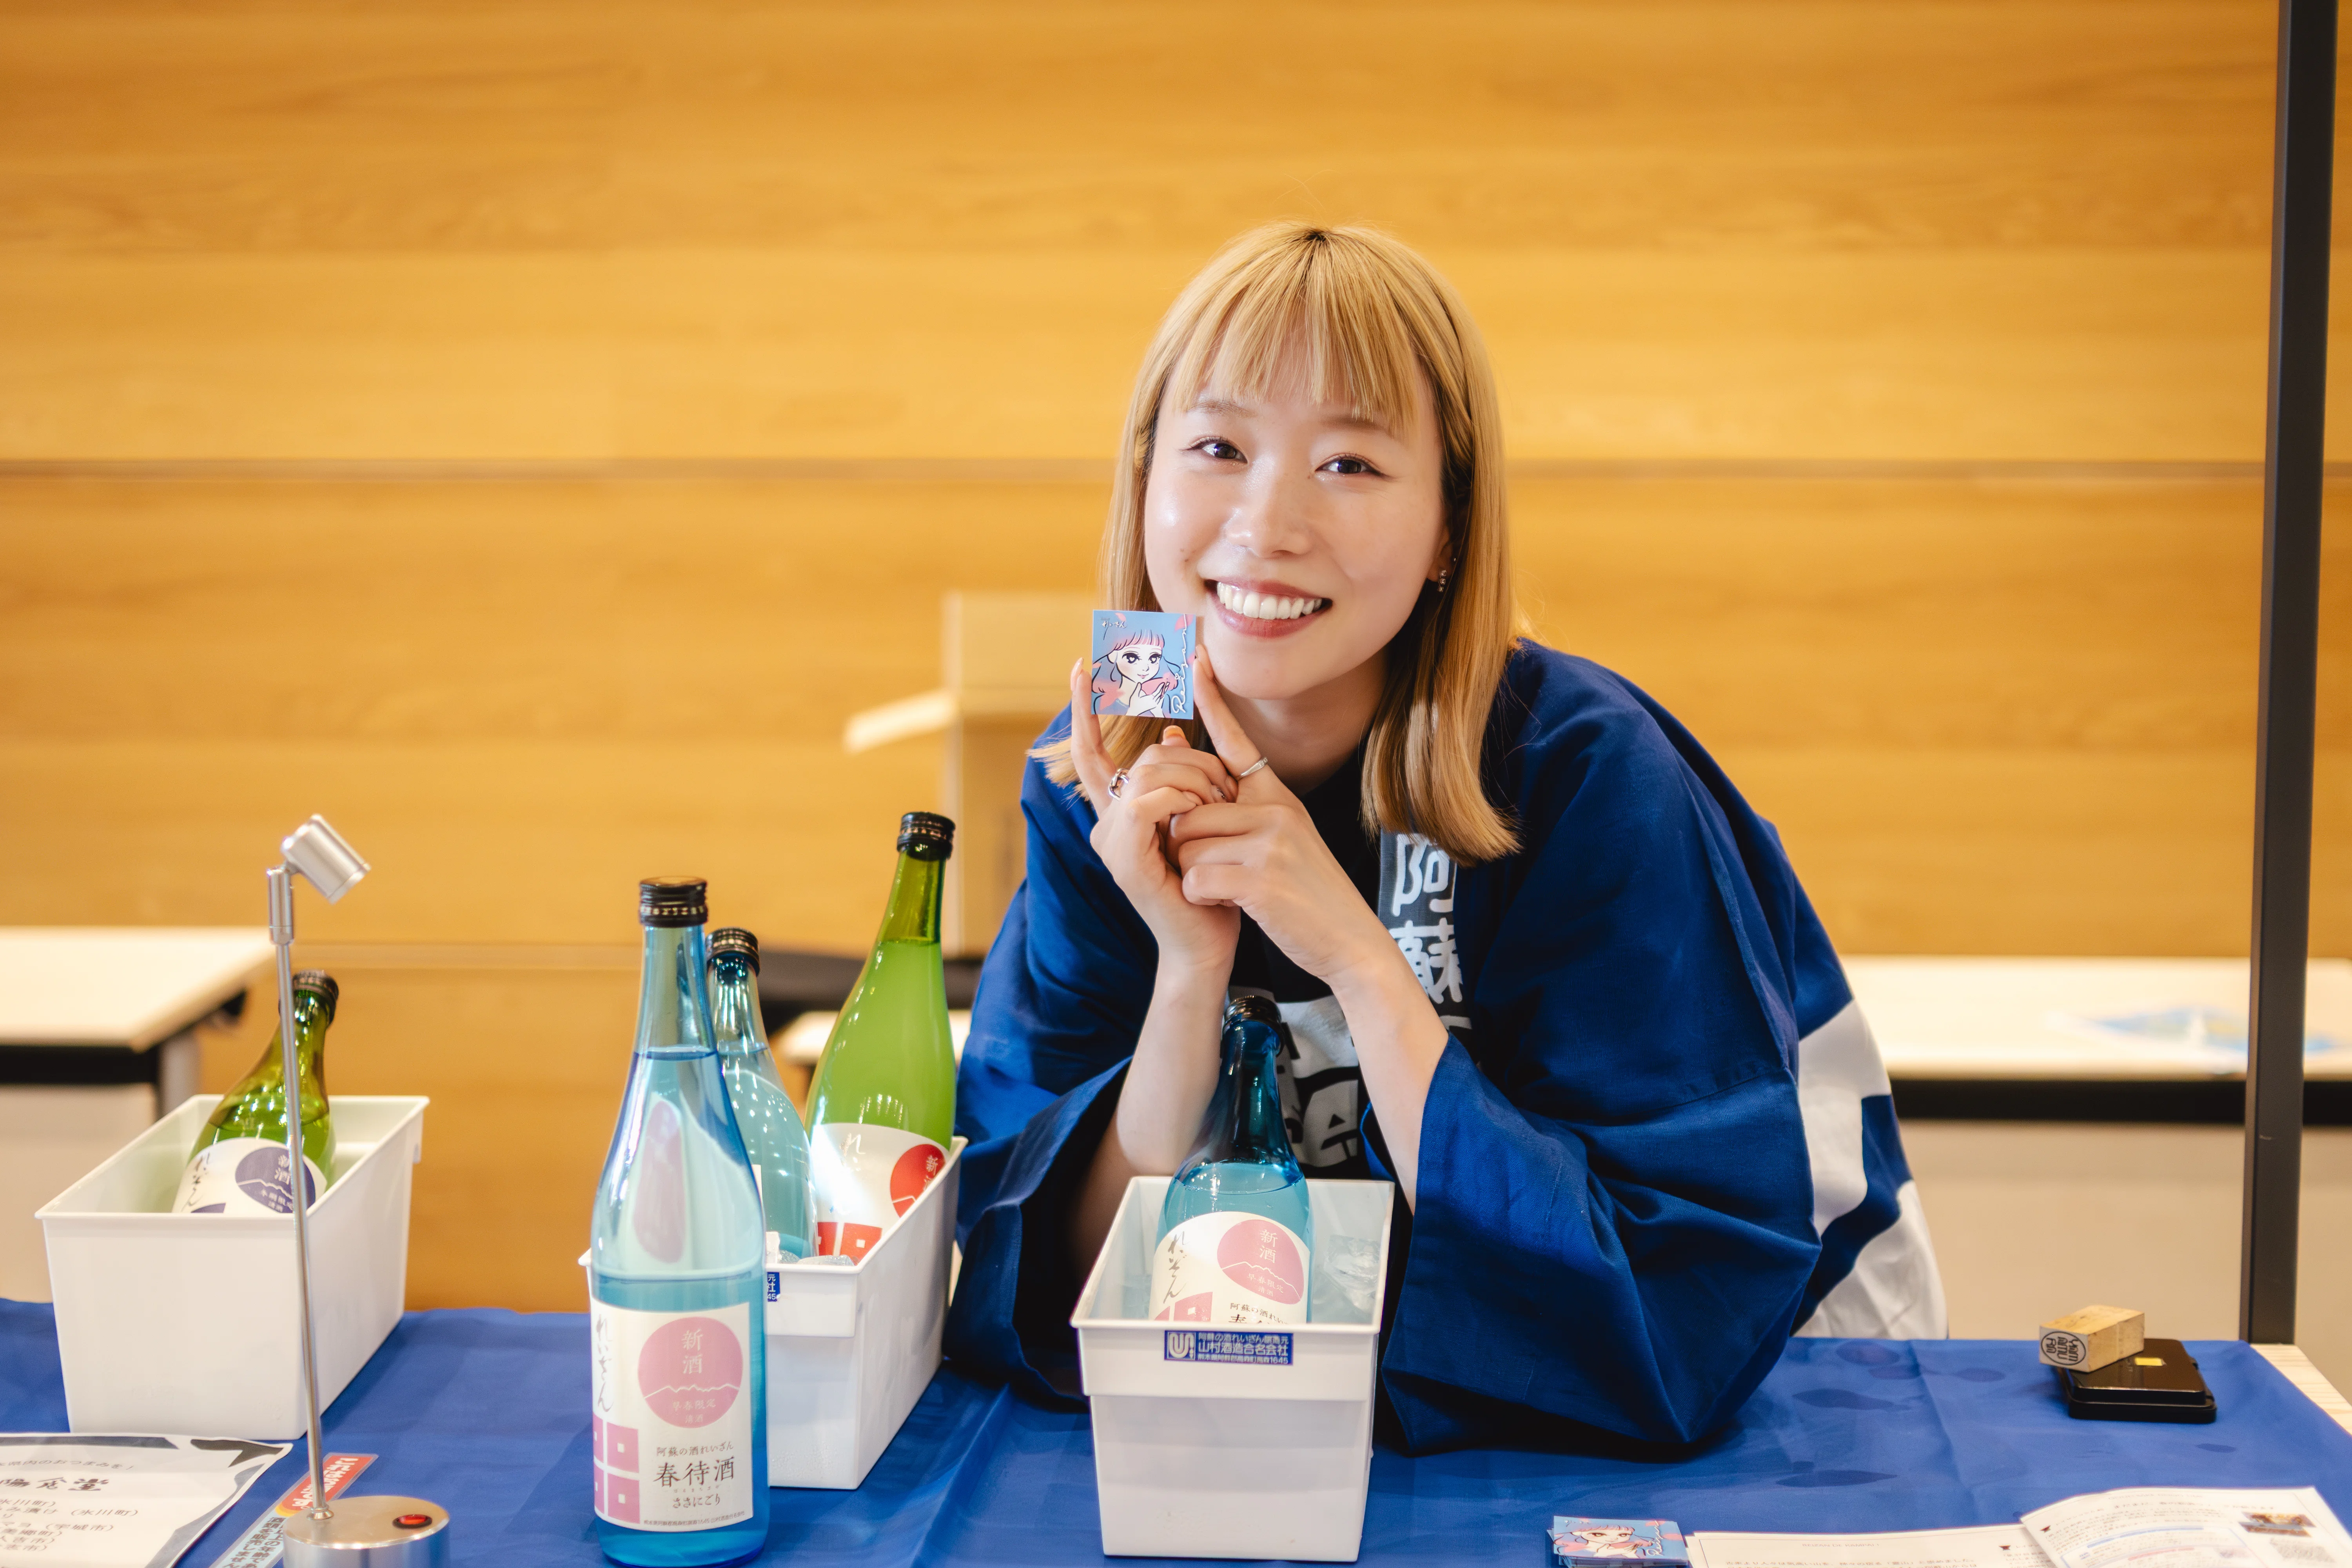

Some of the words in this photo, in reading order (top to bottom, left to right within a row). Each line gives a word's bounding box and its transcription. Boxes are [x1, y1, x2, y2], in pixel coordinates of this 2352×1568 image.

[1389, 833, 1472, 1030] 阿蘇
[1259, 1229, 1278, 1263] 新酒
[1247, 1273, 1284, 1293] 早春限定
[1258, 1286, 1274, 1297] 清酒
[1230, 1303, 1289, 1324] 阿蘇の酒れい
[681, 1328, 704, 1375] 新酒
[1198, 1341, 1289, 1356] 山村酒造合名会社
[656, 1441, 734, 1457] 阿蘇の酒れいざん
[653, 1456, 735, 1488] 春待酒
[672, 1493, 720, 1508] ささにごり
